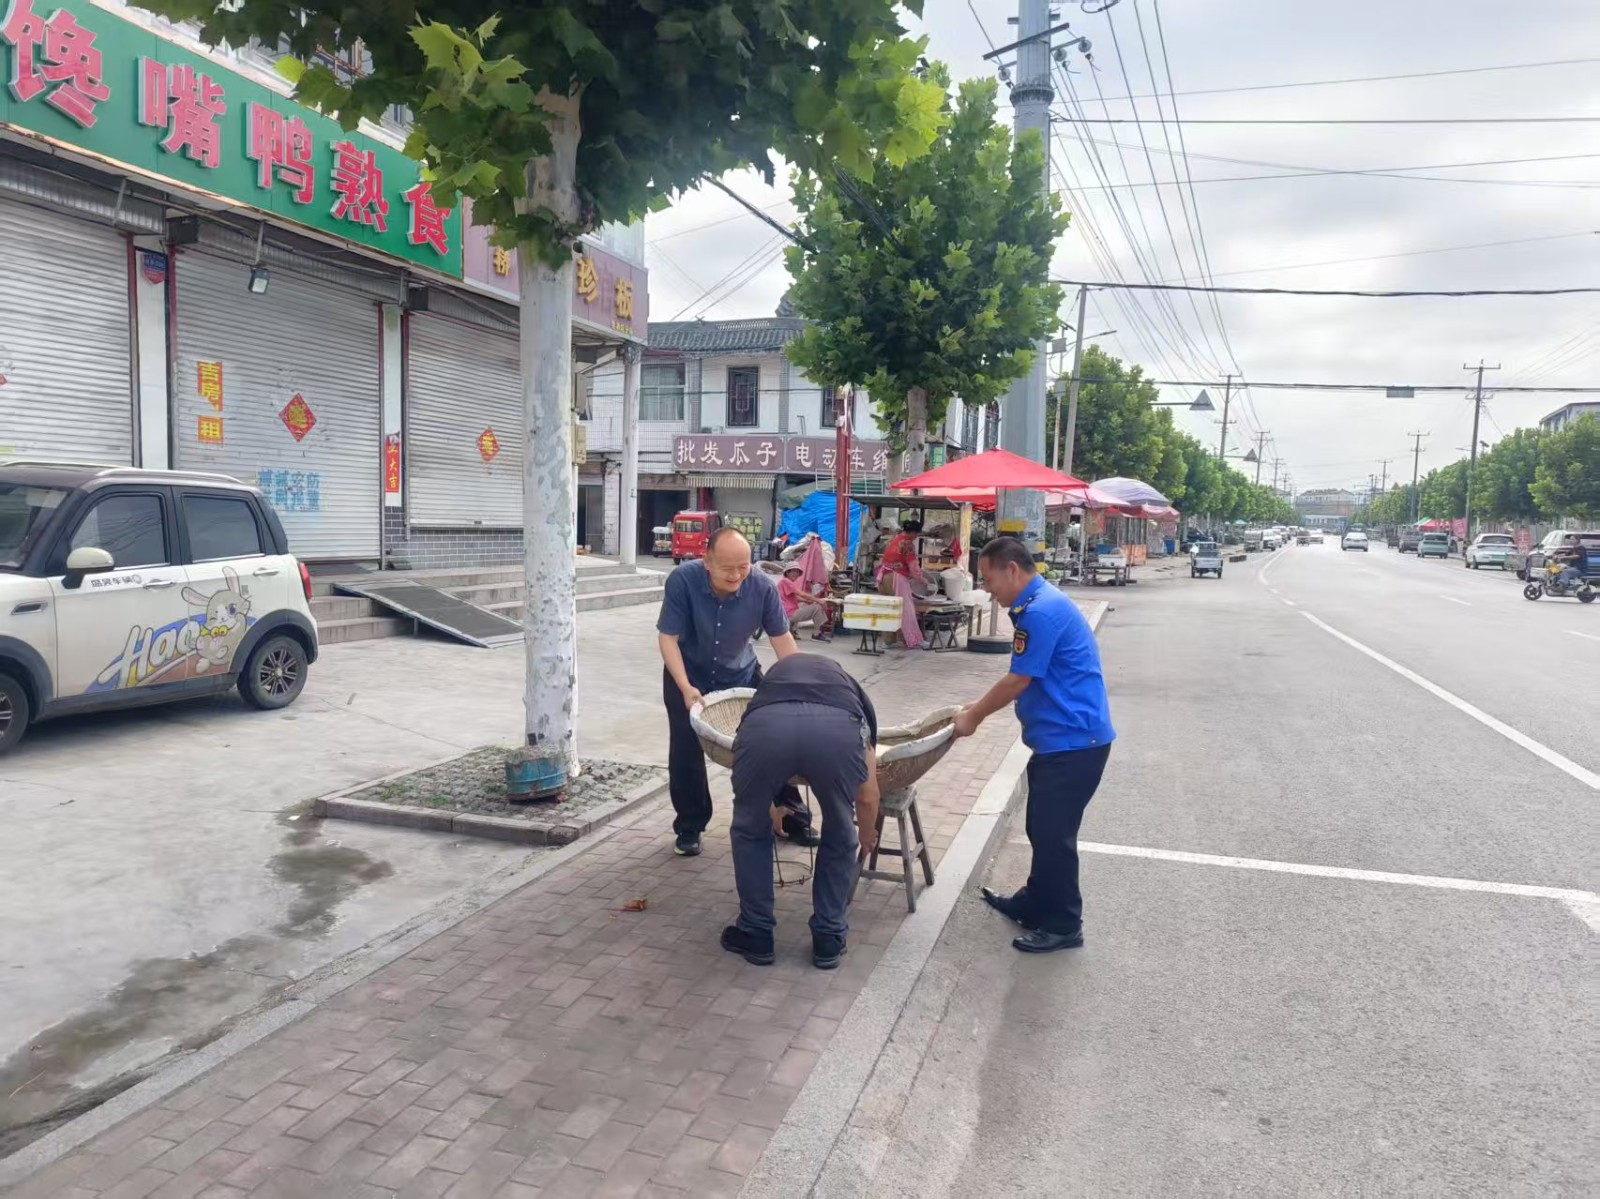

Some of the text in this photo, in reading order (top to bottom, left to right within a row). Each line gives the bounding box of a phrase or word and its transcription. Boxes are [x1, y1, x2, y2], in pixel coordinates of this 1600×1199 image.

[1, 0, 451, 256] 馋嘴鸭熟食
[677, 440, 777, 467] 批发瓜子
